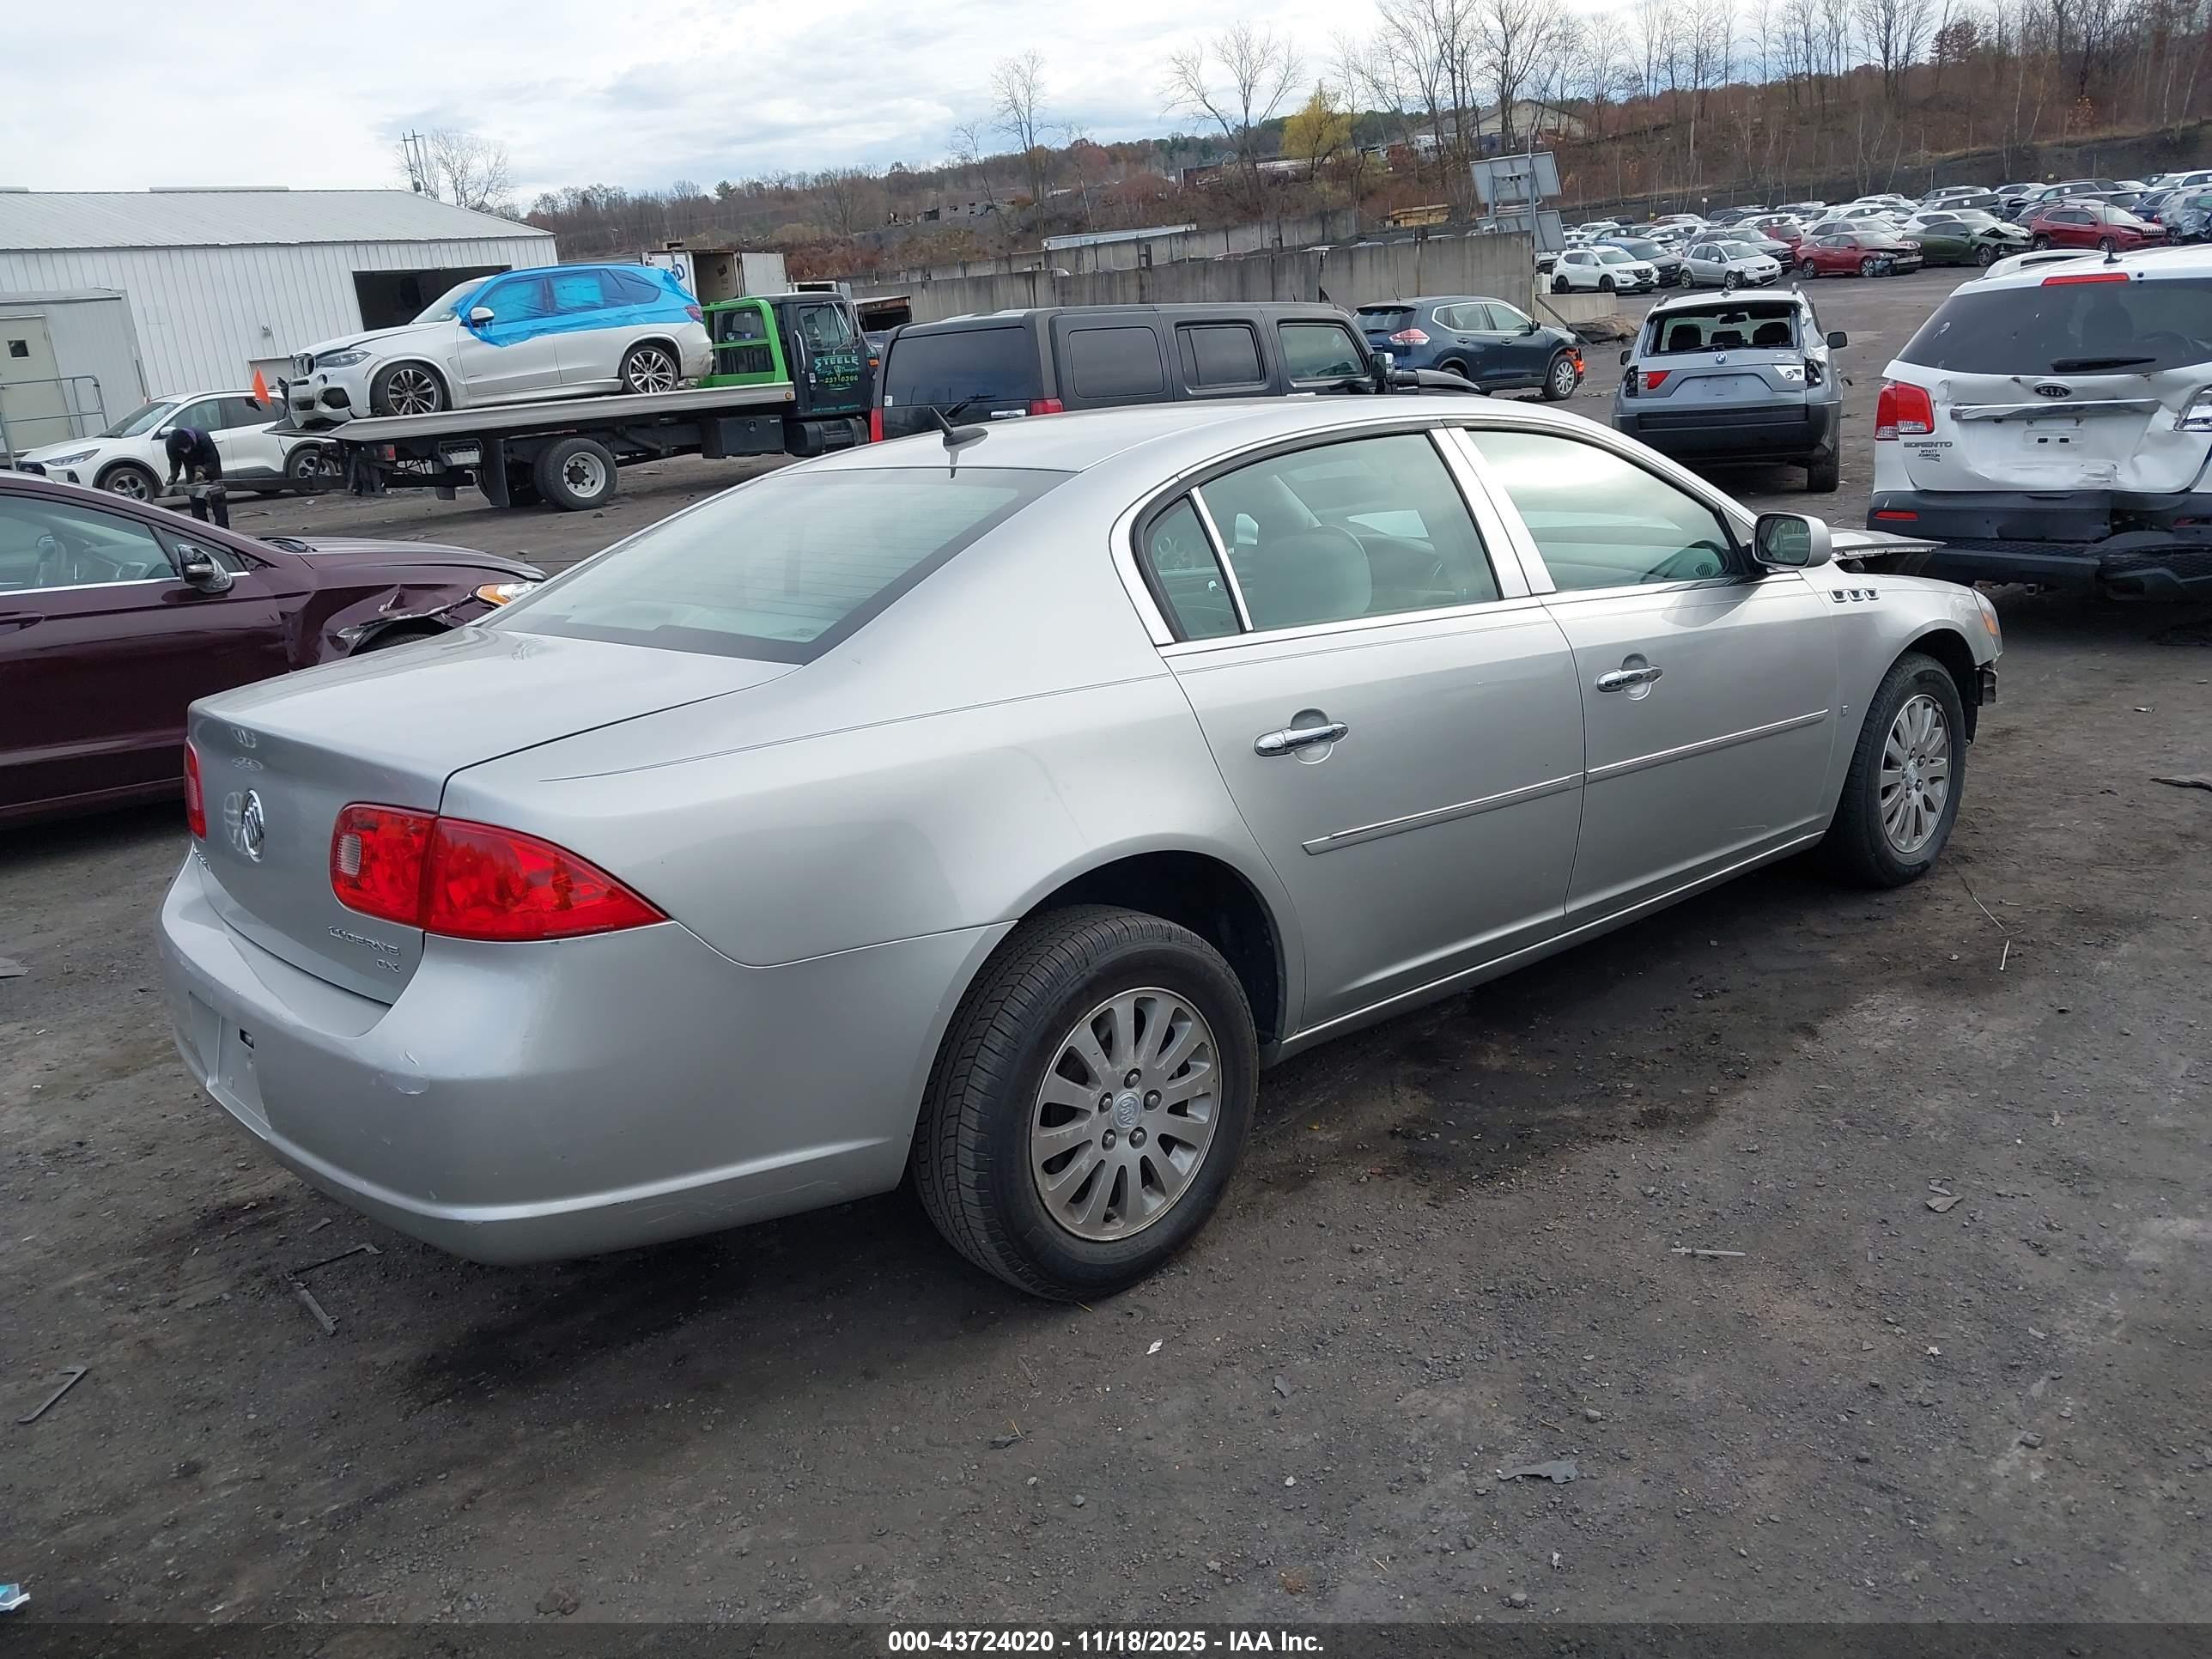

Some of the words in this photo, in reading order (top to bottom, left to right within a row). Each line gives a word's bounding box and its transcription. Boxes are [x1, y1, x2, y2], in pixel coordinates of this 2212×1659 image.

[815, 356, 859, 370] STEELE
[2039, 386, 2067, 397] KIA
[328, 926, 401, 956] LUCERNE
[376, 958, 402, 973] CX
